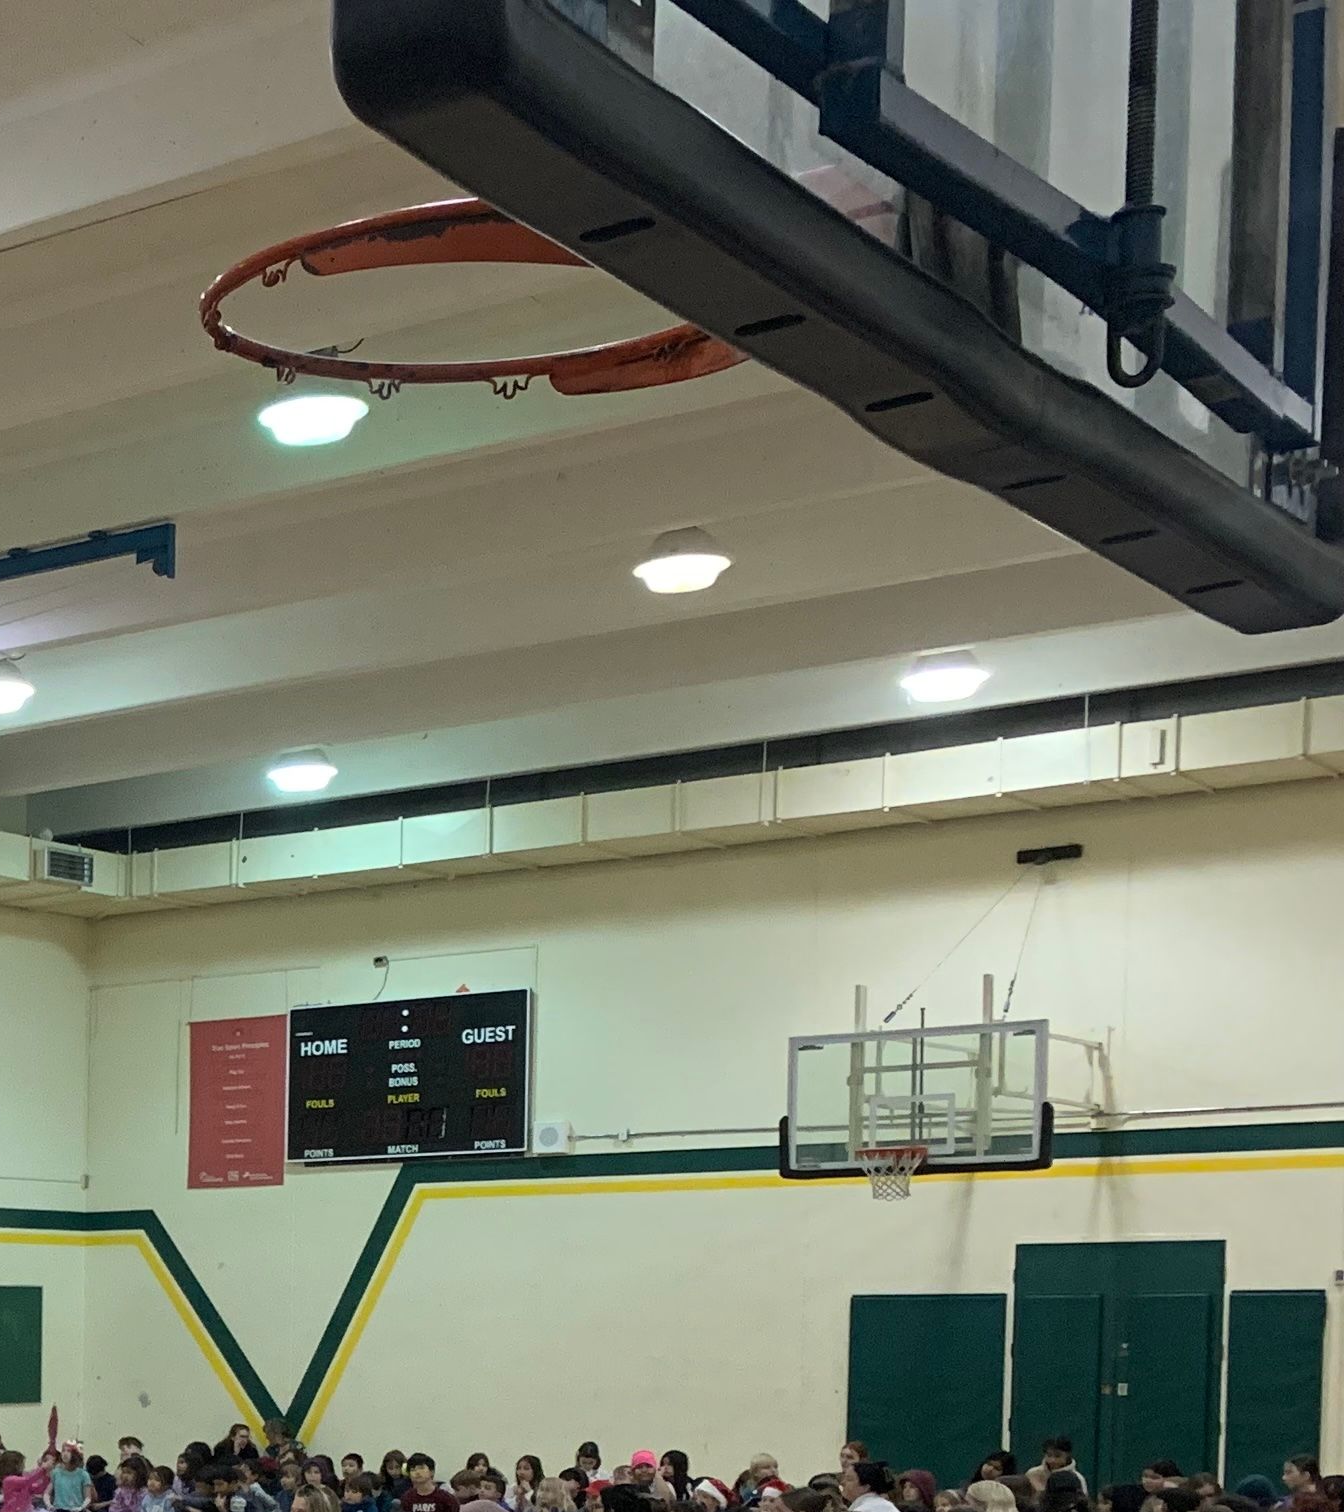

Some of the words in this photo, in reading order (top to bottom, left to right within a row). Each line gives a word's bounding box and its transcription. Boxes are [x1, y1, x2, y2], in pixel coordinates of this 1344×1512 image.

[461, 1025, 516, 1045] GUEST
[300, 1038, 348, 1057] HOME
[388, 1038, 421, 1050] PERIOD
[391, 1063, 417, 1074] POSS.
[388, 1076, 418, 1088] BONUS
[387, 1092, 420, 1104] PLAYER
[475, 1087, 507, 1099] FOULS
[305, 1099, 335, 1109] FOULS
[387, 1144, 419, 1154] MATCH
[474, 1139, 506, 1150] POINTS
[304, 1148, 334, 1158] POINTS
